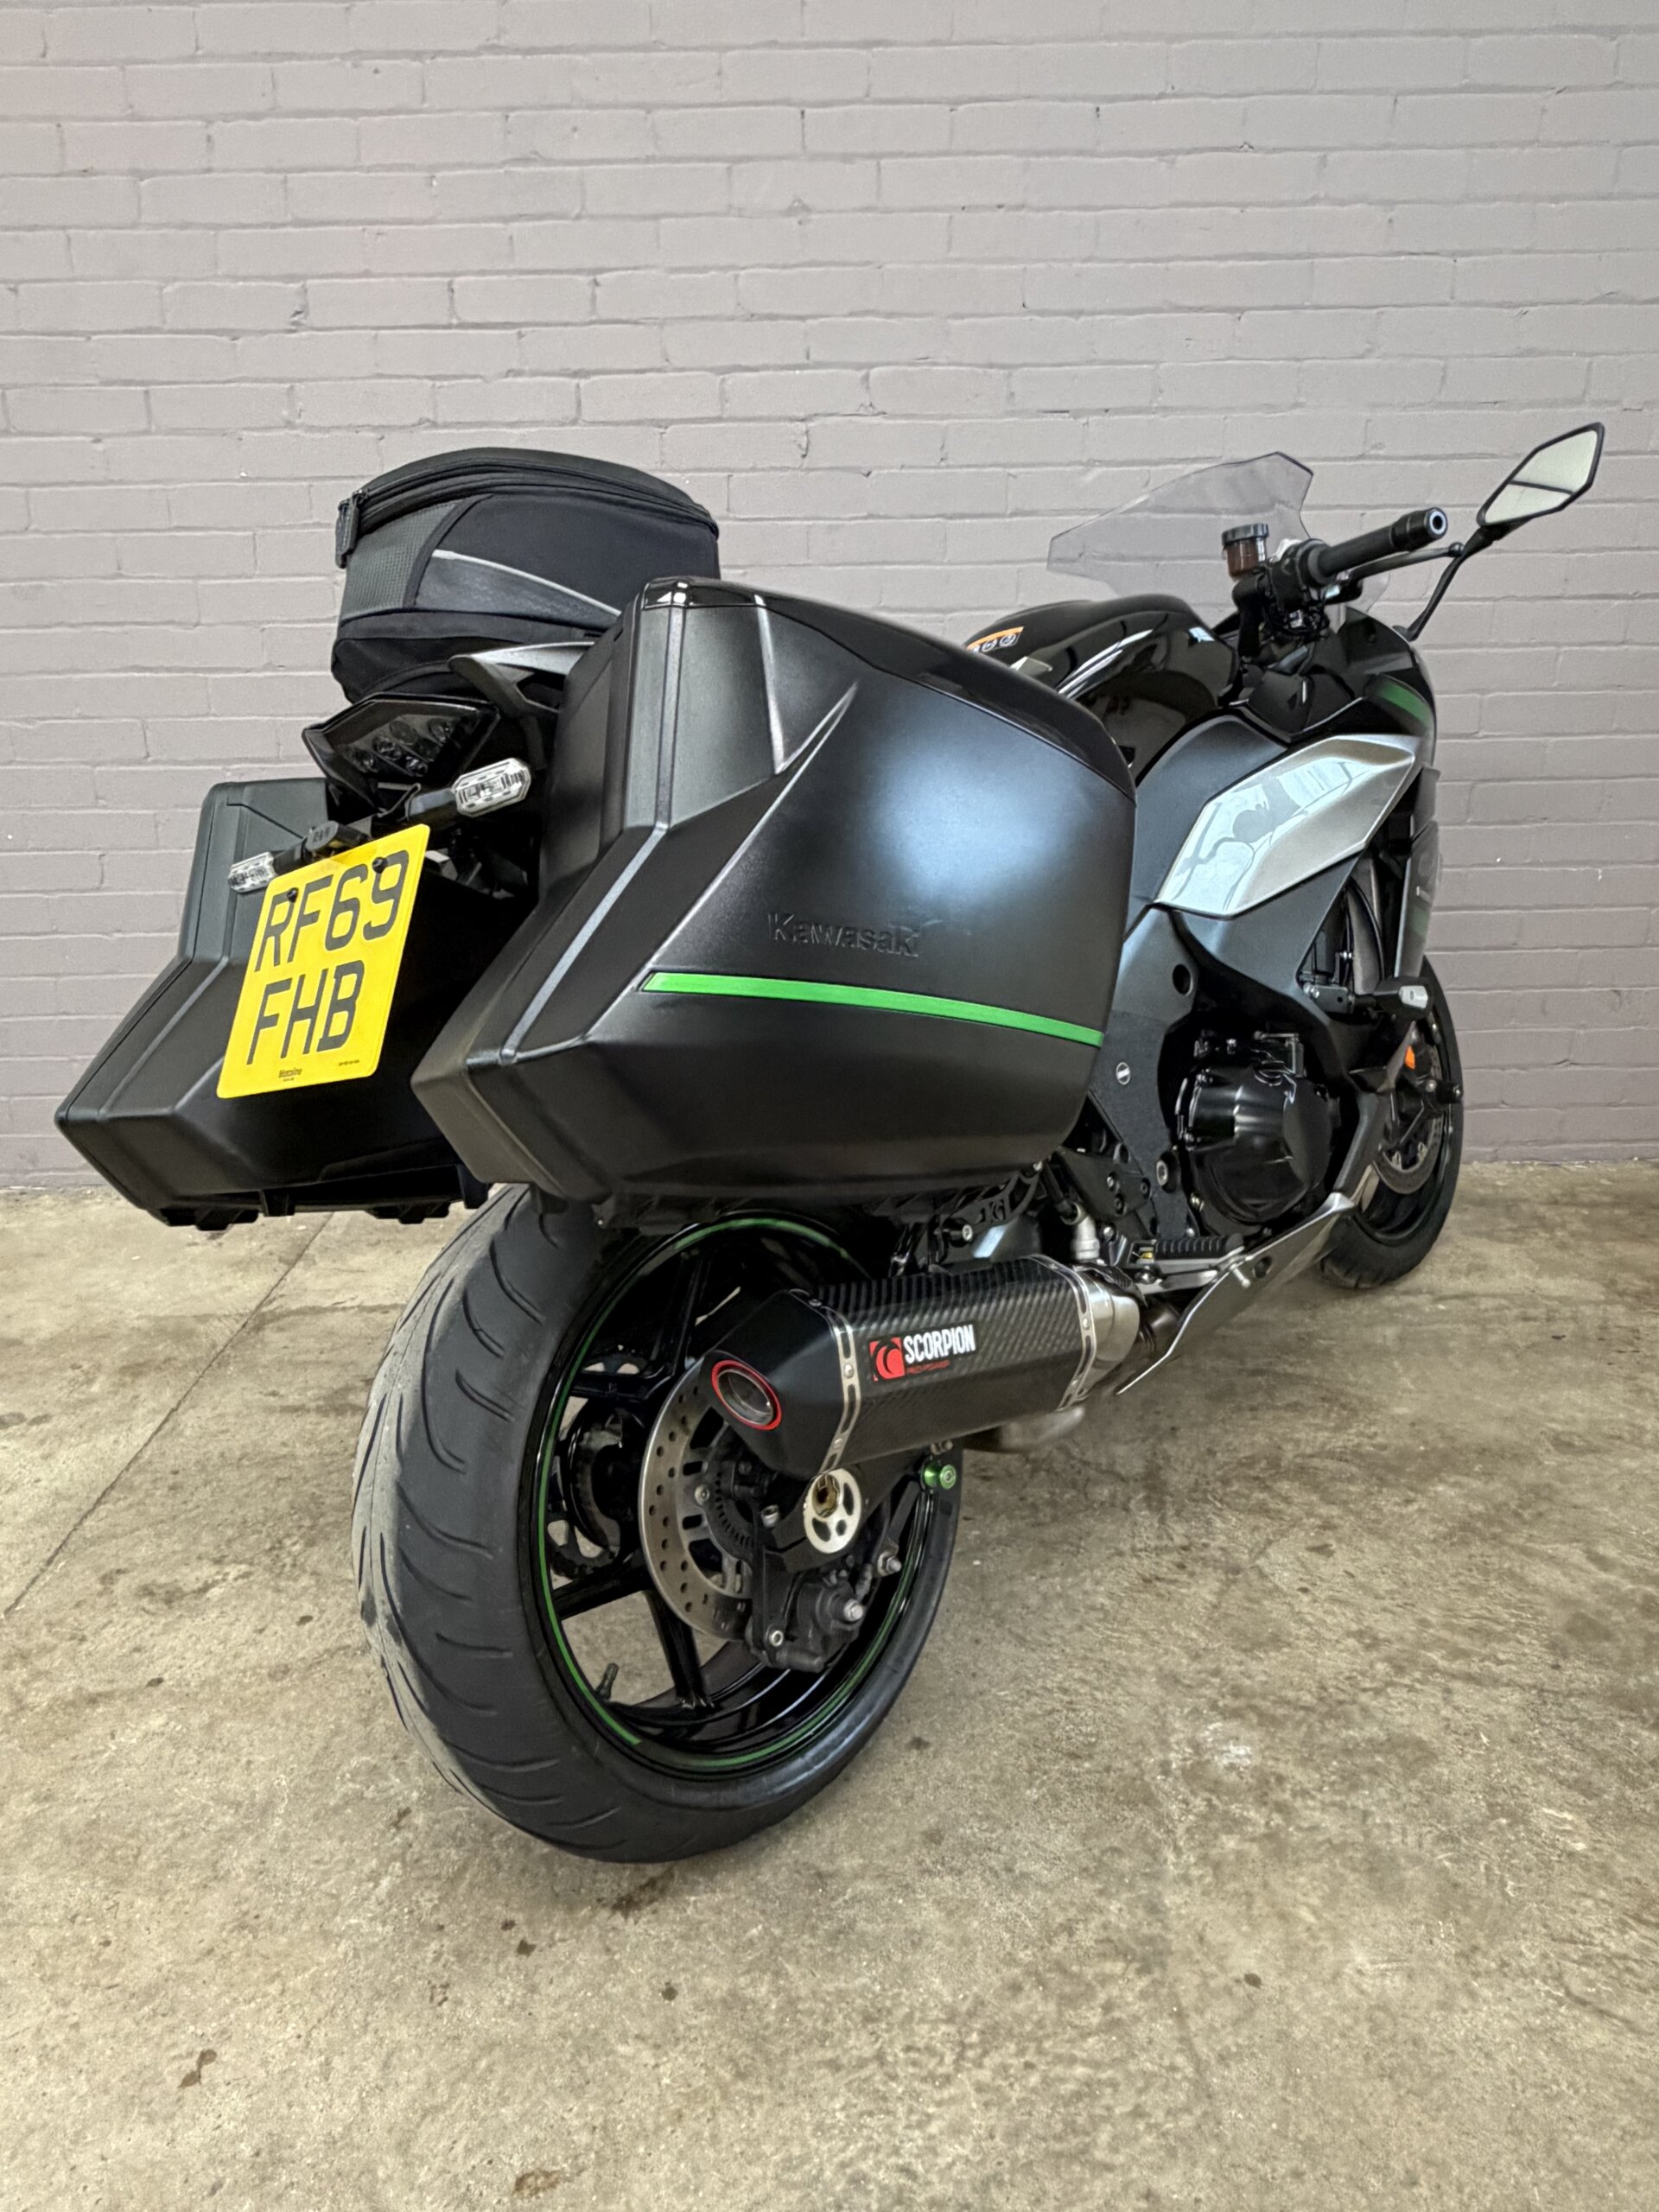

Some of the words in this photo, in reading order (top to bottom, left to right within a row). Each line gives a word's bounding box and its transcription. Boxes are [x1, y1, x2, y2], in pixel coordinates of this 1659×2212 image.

[254, 849, 409, 972] RF69
[246, 960, 365, 1065] FHB
[903, 1324, 976, 1363] SCORPION
